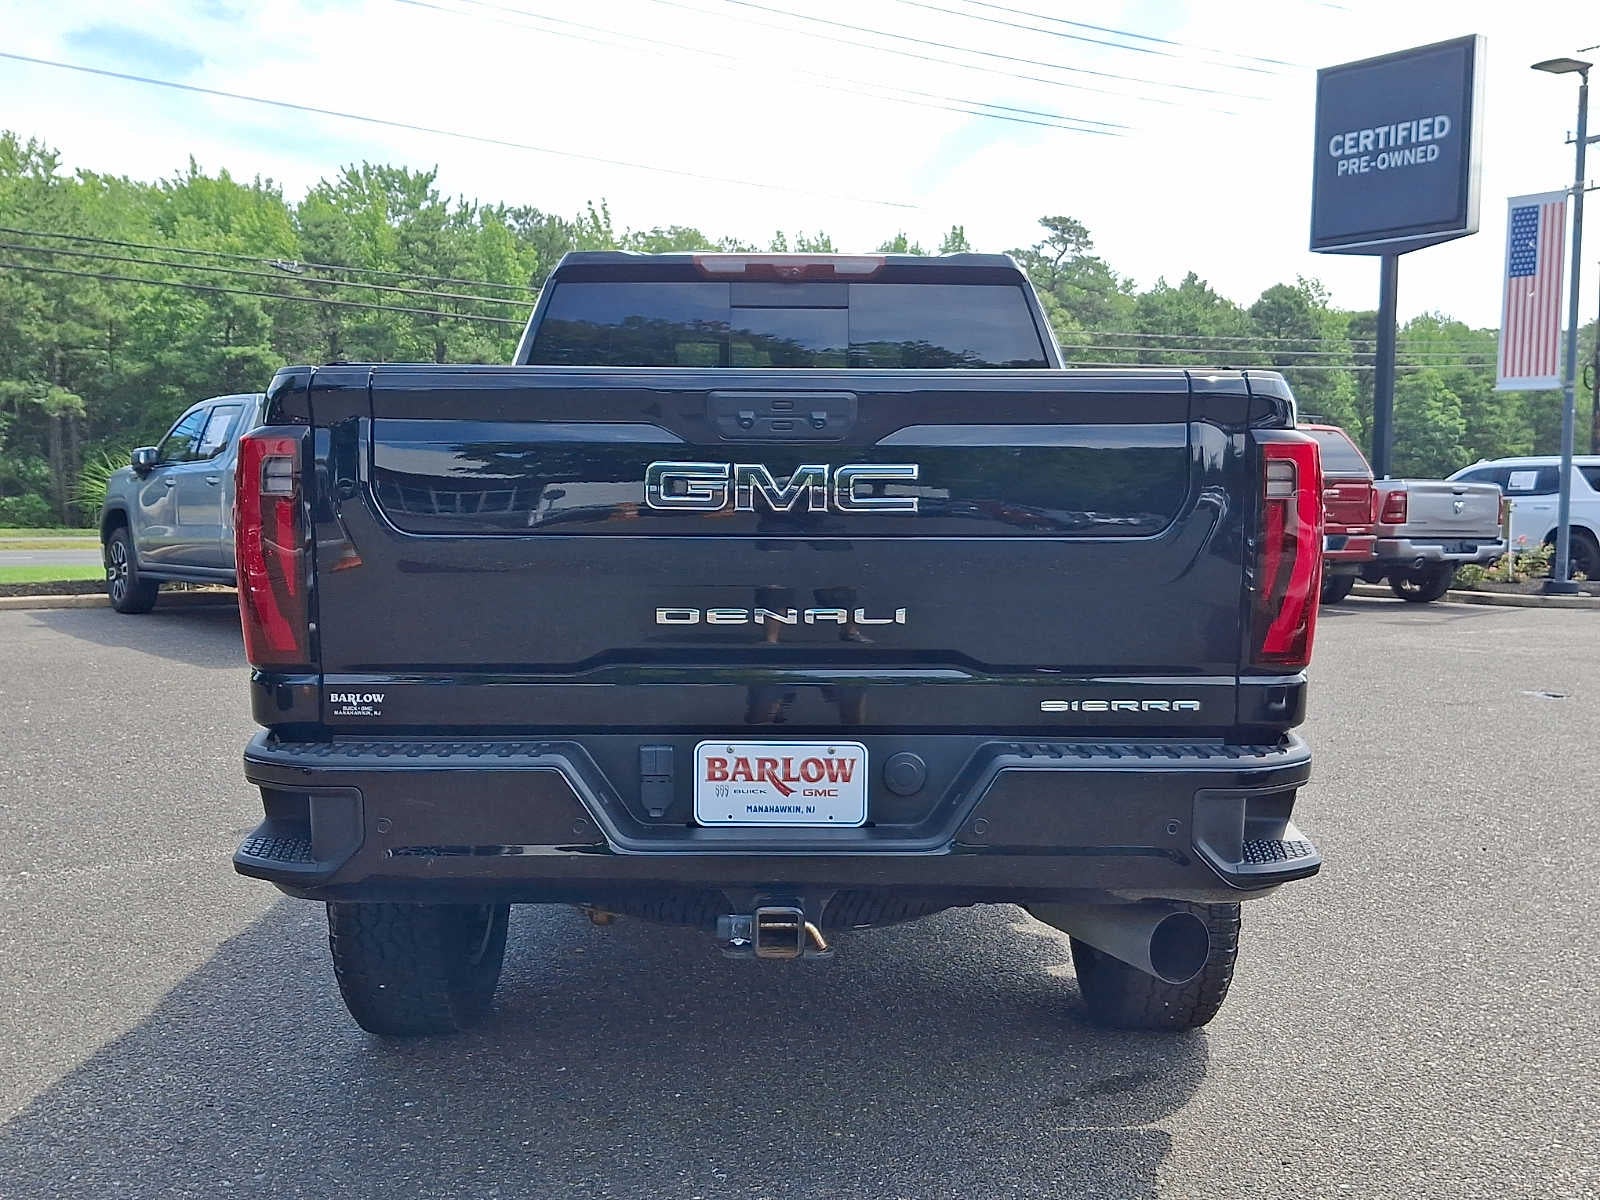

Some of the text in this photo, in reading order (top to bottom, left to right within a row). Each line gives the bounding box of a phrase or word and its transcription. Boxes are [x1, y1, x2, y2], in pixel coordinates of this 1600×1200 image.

[1329, 115, 1451, 158] CERTIFIED
[1337, 144, 1440, 177] PRE-OWNED
[645, 461, 919, 512] GMC
[656, 608, 906, 625] DENALI
[330, 693, 385, 705] BARLOW
[1040, 700, 1201, 712] SIERRA
[705, 757, 857, 797] BARLOW
[803, 788, 839, 797] GMC
[746, 805, 816, 814] MANAHAWKIN, NJ
